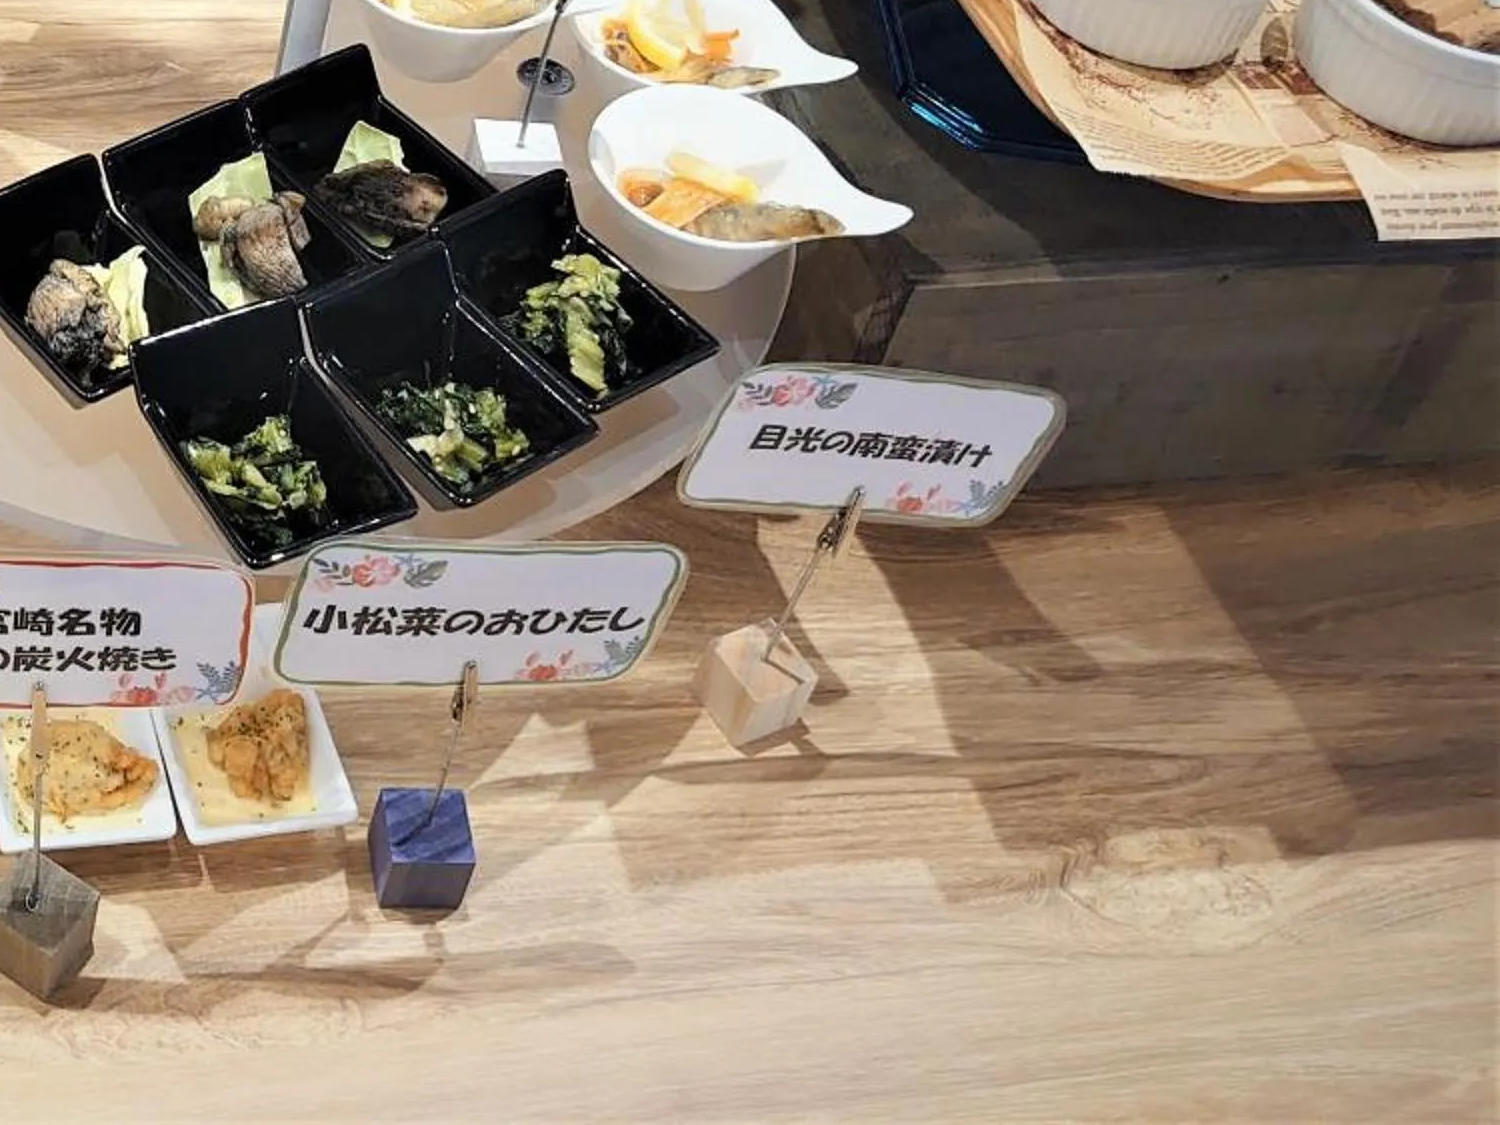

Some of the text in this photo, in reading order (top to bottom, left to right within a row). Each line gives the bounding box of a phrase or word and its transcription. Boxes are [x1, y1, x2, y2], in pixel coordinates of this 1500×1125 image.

[749, 424, 992, 468] 目光の南蛮漬け
[303, 604, 645, 636] 小松菜のおひたし
